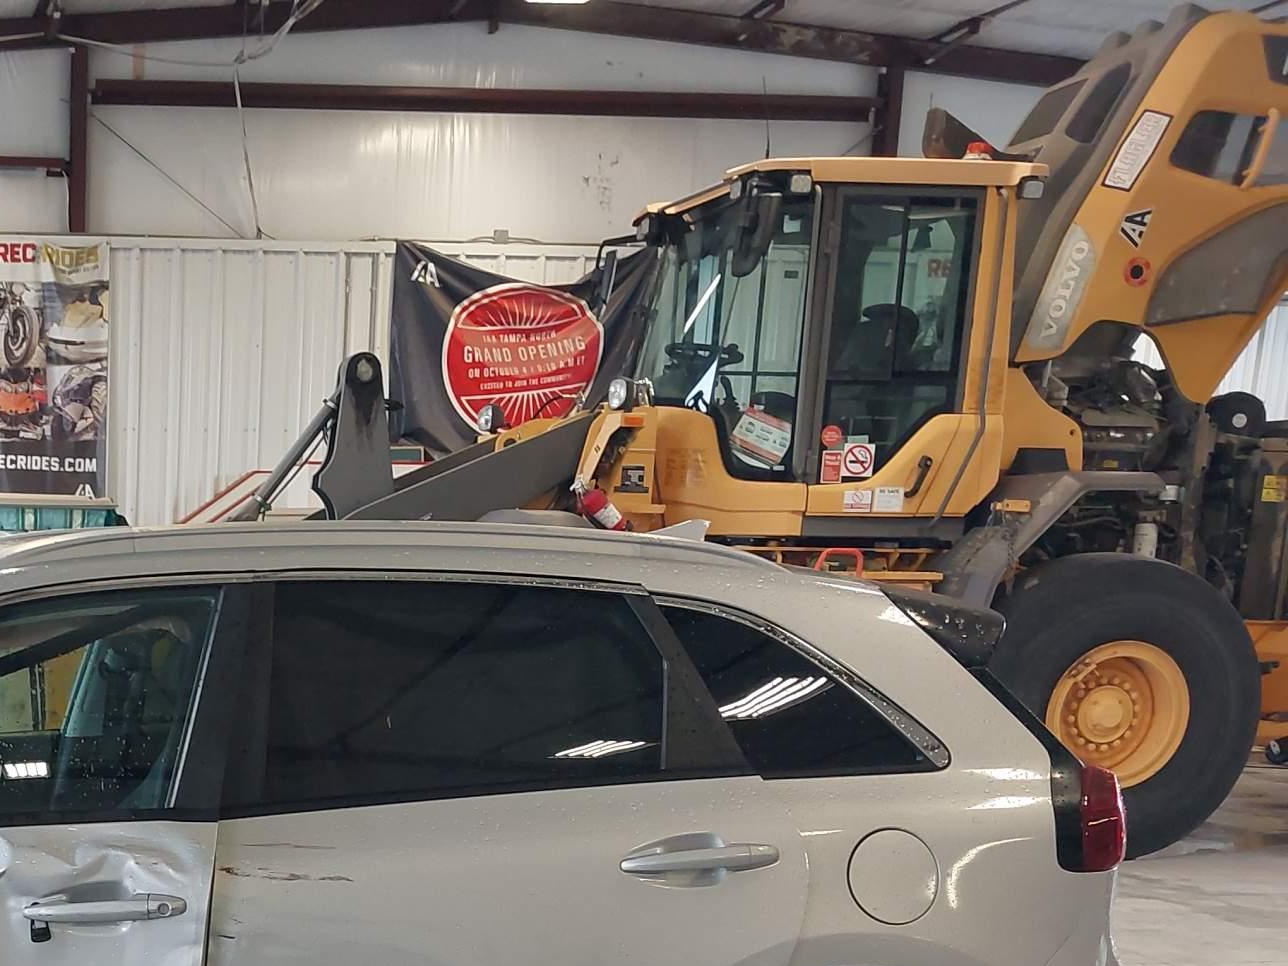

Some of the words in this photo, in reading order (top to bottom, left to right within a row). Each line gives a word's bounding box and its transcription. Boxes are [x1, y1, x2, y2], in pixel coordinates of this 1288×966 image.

[1040, 240, 1089, 337] VOLVO
[464, 345, 512, 363] GRAND
[518, 336, 586, 361] OPENING
[499, 333, 527, 343] TAMPA
